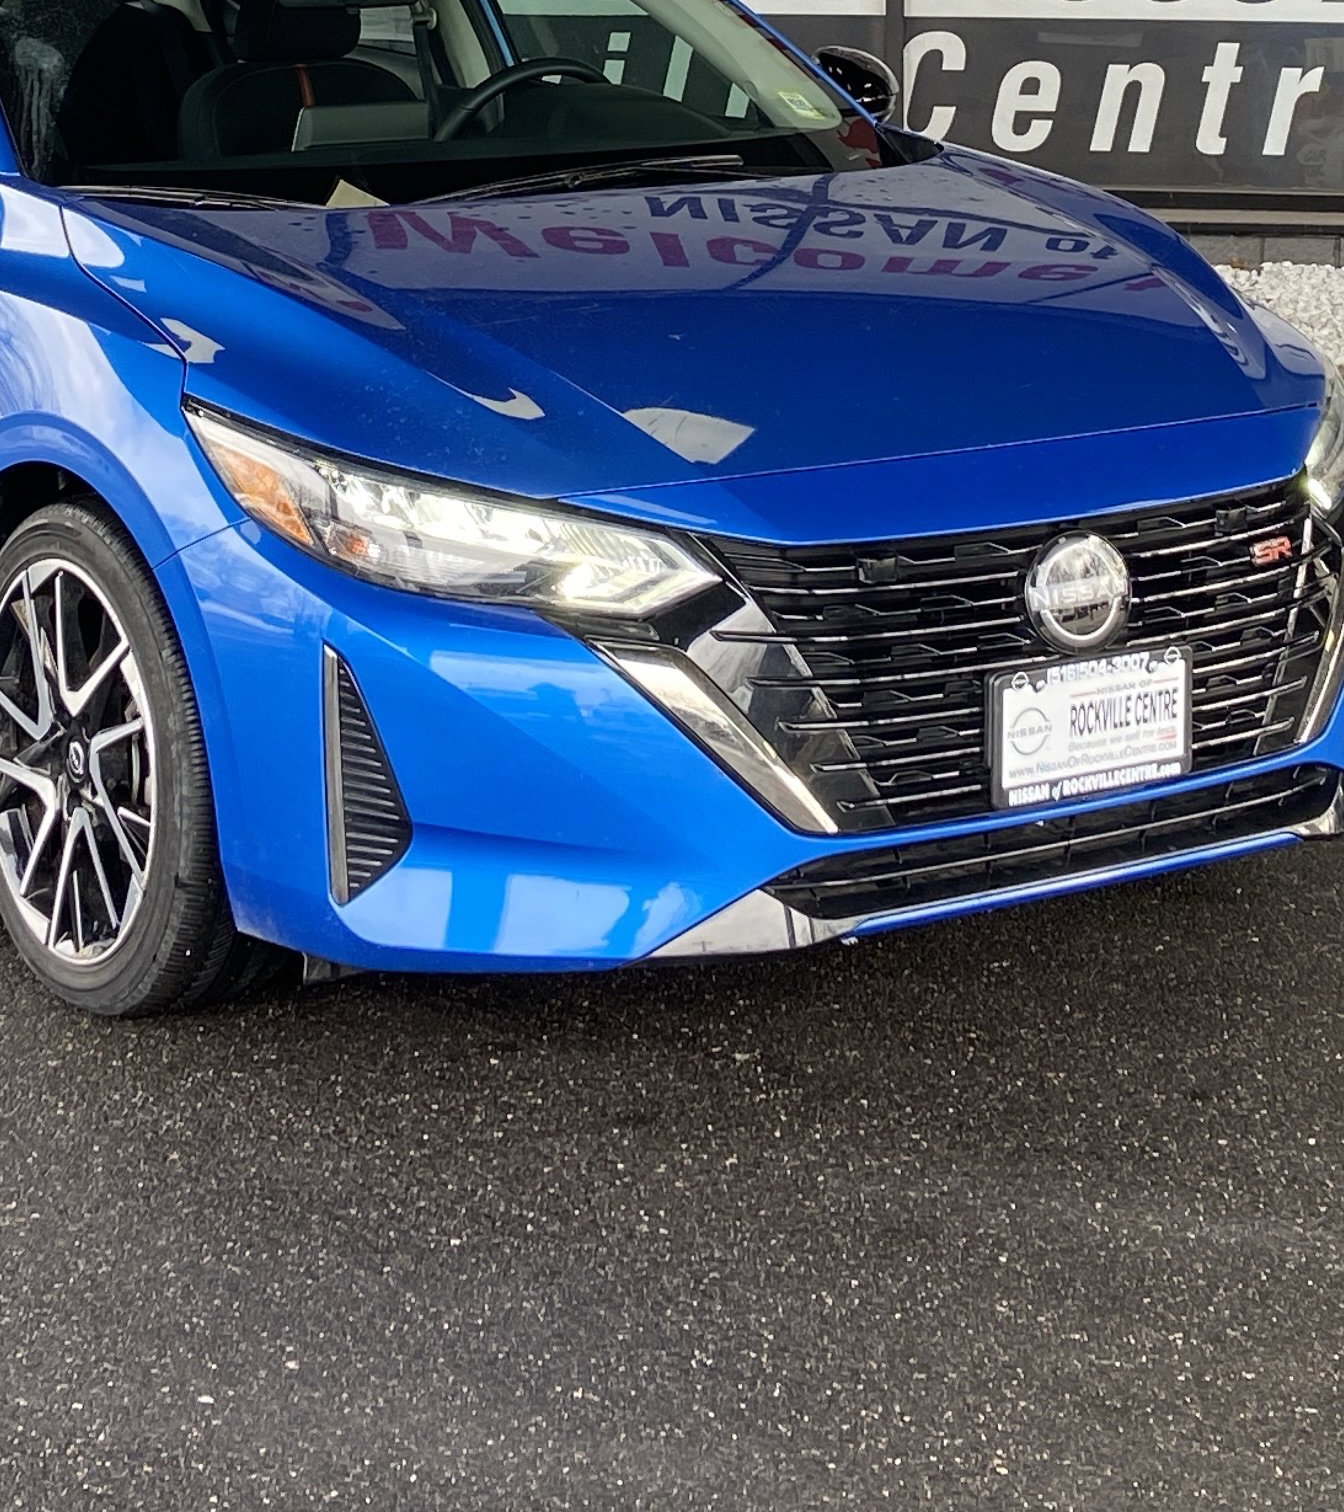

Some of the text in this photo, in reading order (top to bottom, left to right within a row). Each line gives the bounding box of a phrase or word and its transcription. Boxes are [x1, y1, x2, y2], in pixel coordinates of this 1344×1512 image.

[1250, 536, 1293, 565] SR
[1029, 577, 1129, 611] NISSAN
[1069, 688, 1179, 737] ROCKVILLE CENTRE
[1007, 723, 1053, 739] NISSAN
[1008, 783, 1050, 807] NISSAN
